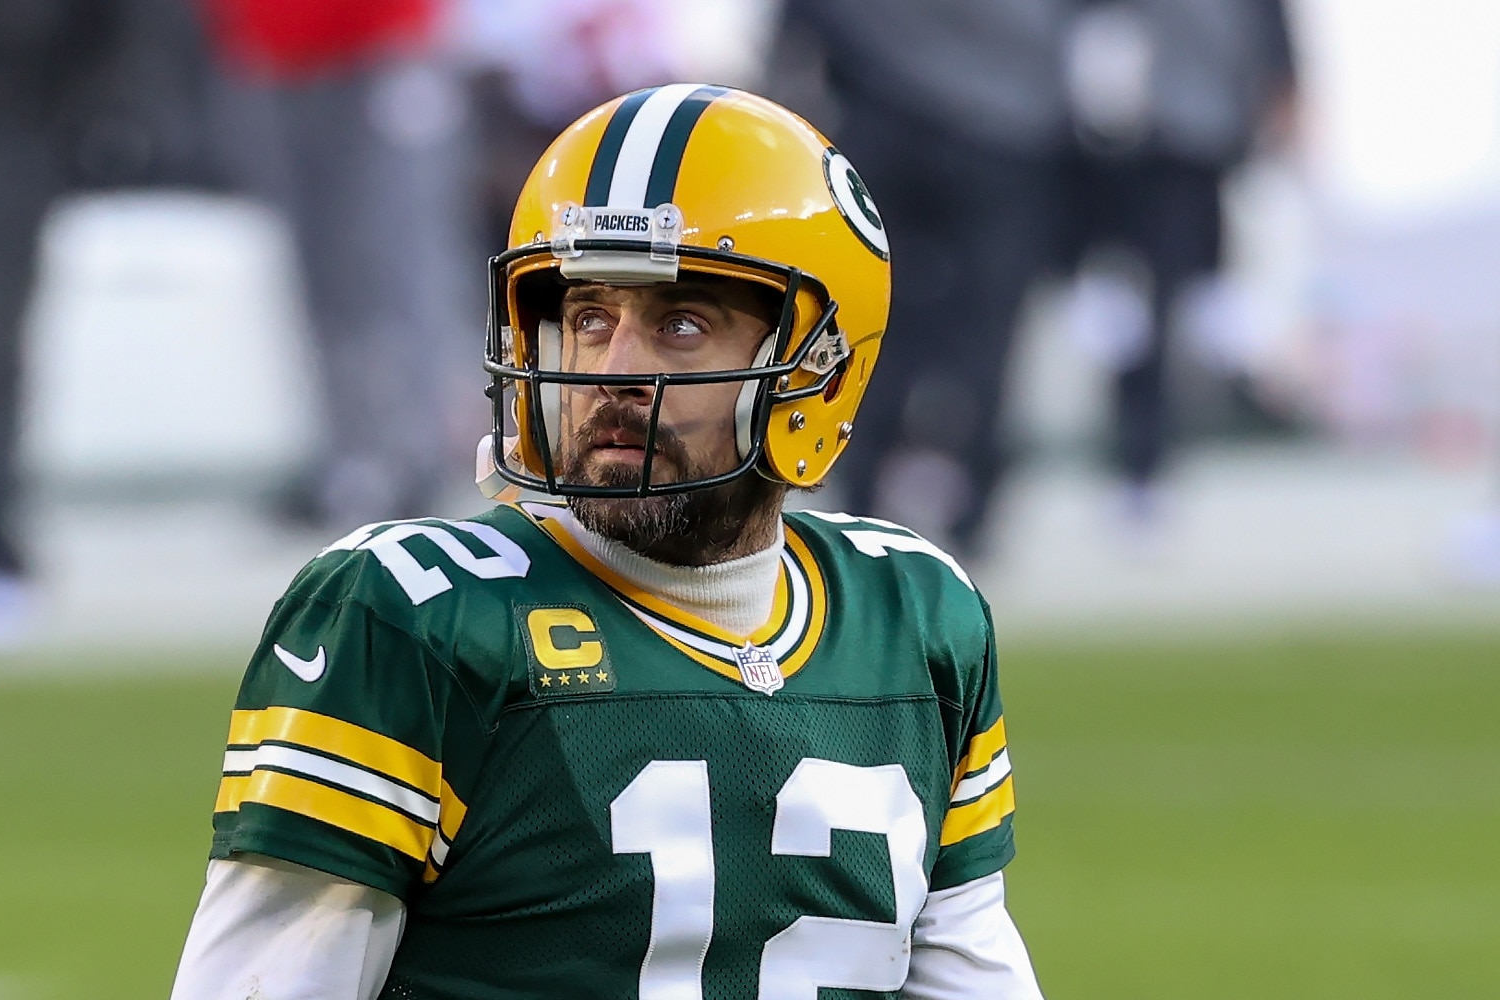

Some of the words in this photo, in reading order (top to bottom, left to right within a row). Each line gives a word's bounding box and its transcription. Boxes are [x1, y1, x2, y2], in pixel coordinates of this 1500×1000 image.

[594, 214, 650, 232] PACKERS
[527, 608, 604, 669] C
[746, 664, 778, 685] NFL
